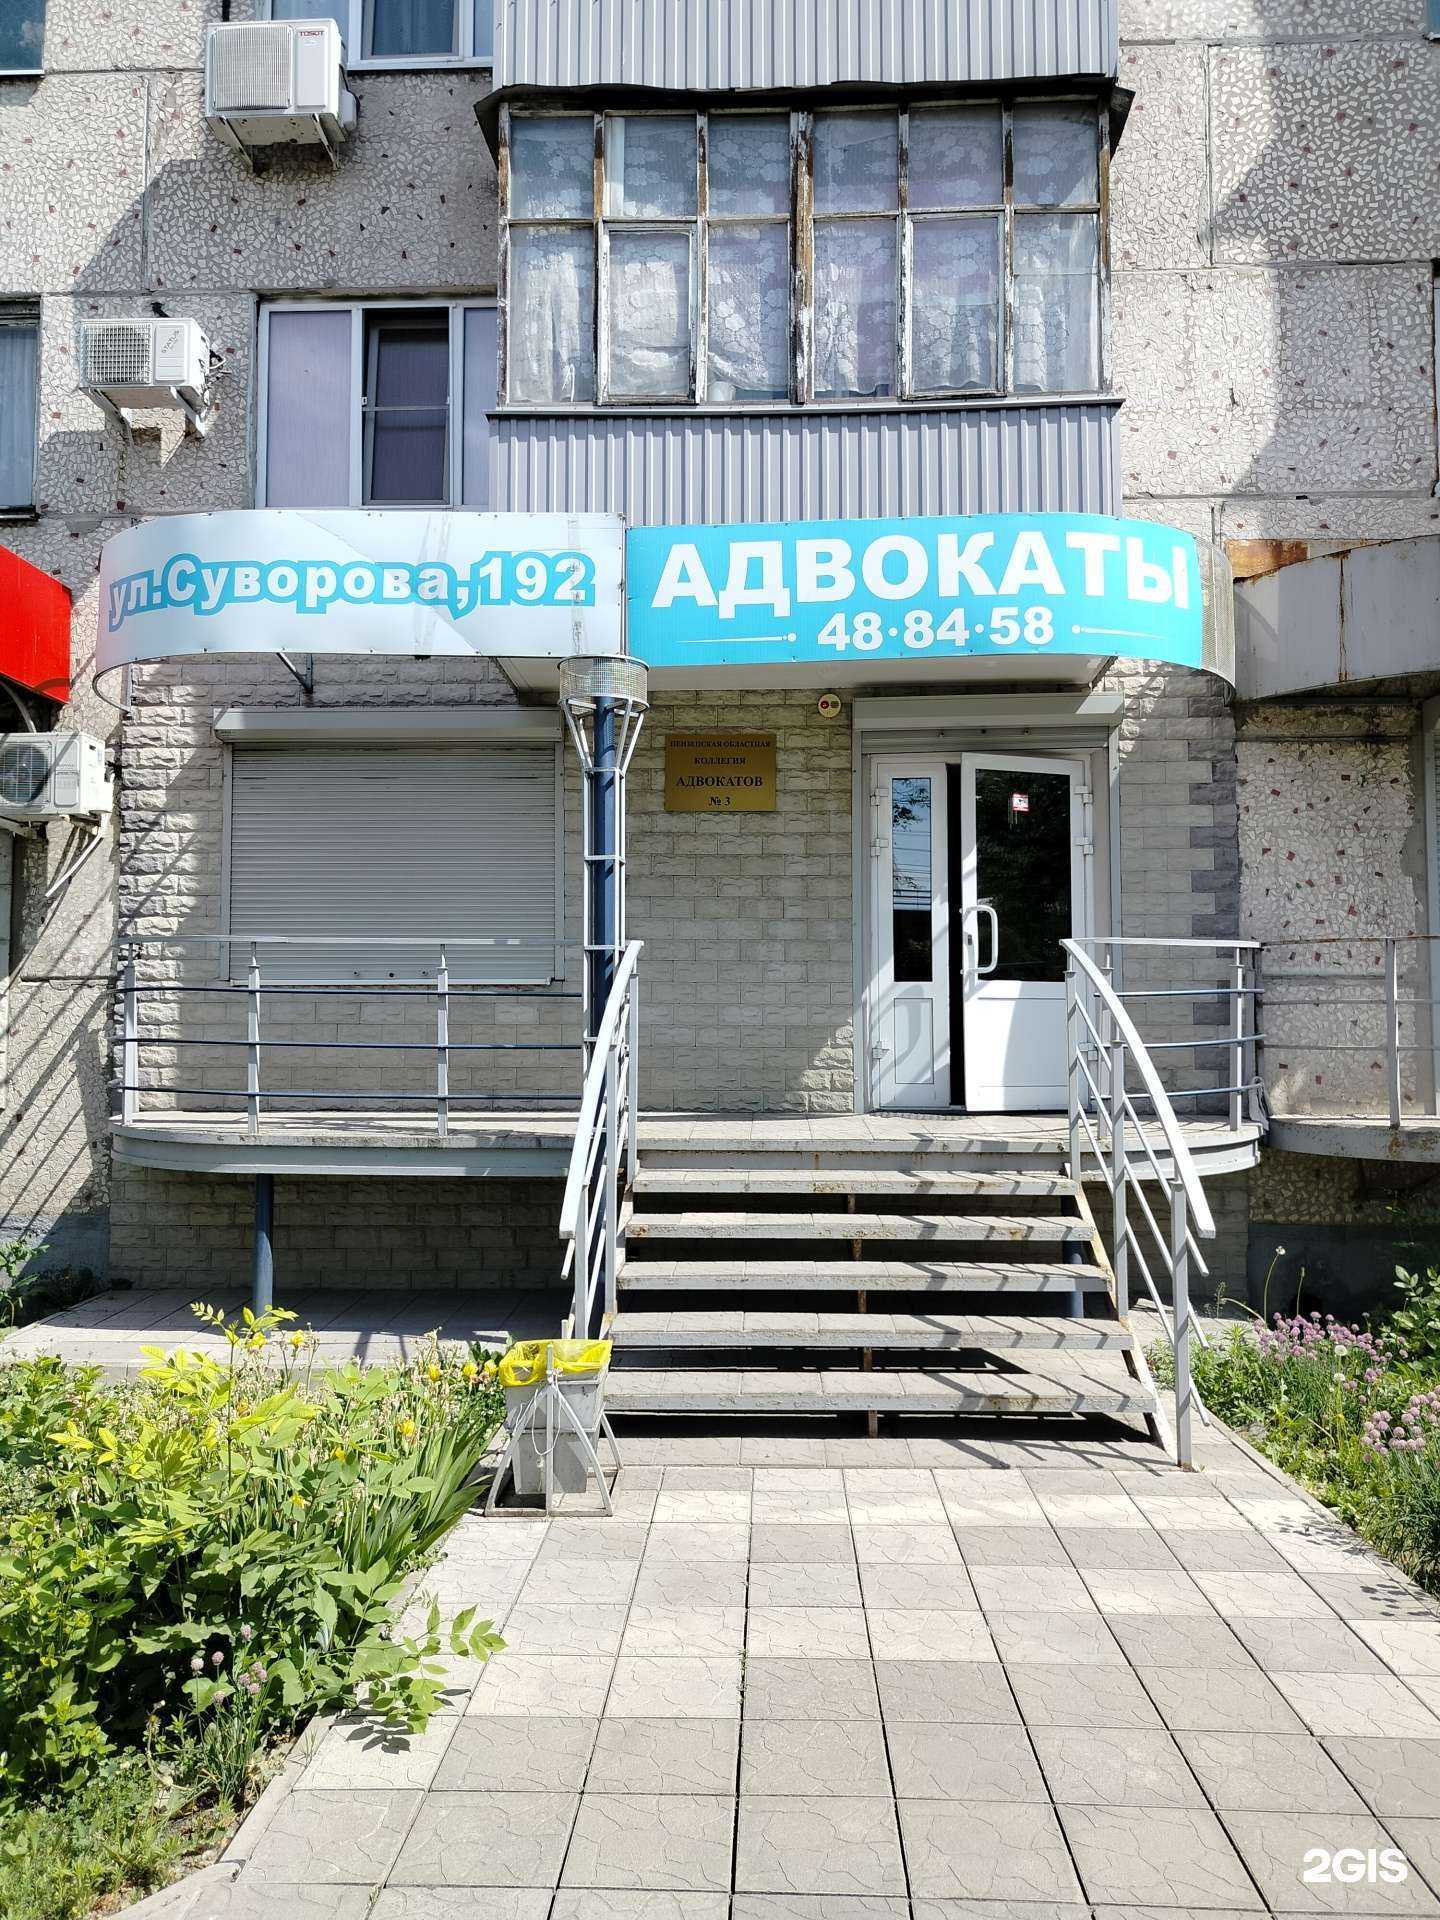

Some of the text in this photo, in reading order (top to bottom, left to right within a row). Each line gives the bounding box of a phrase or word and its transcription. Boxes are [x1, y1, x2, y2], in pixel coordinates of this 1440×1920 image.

[651, 531, 1189, 619] АДВОКАТЫ
[694, 757, 746, 765] КОЛЛЕГИЯ
[676, 776, 763, 789] АДВОКАТОВ
[724, 796, 731, 806] 3
